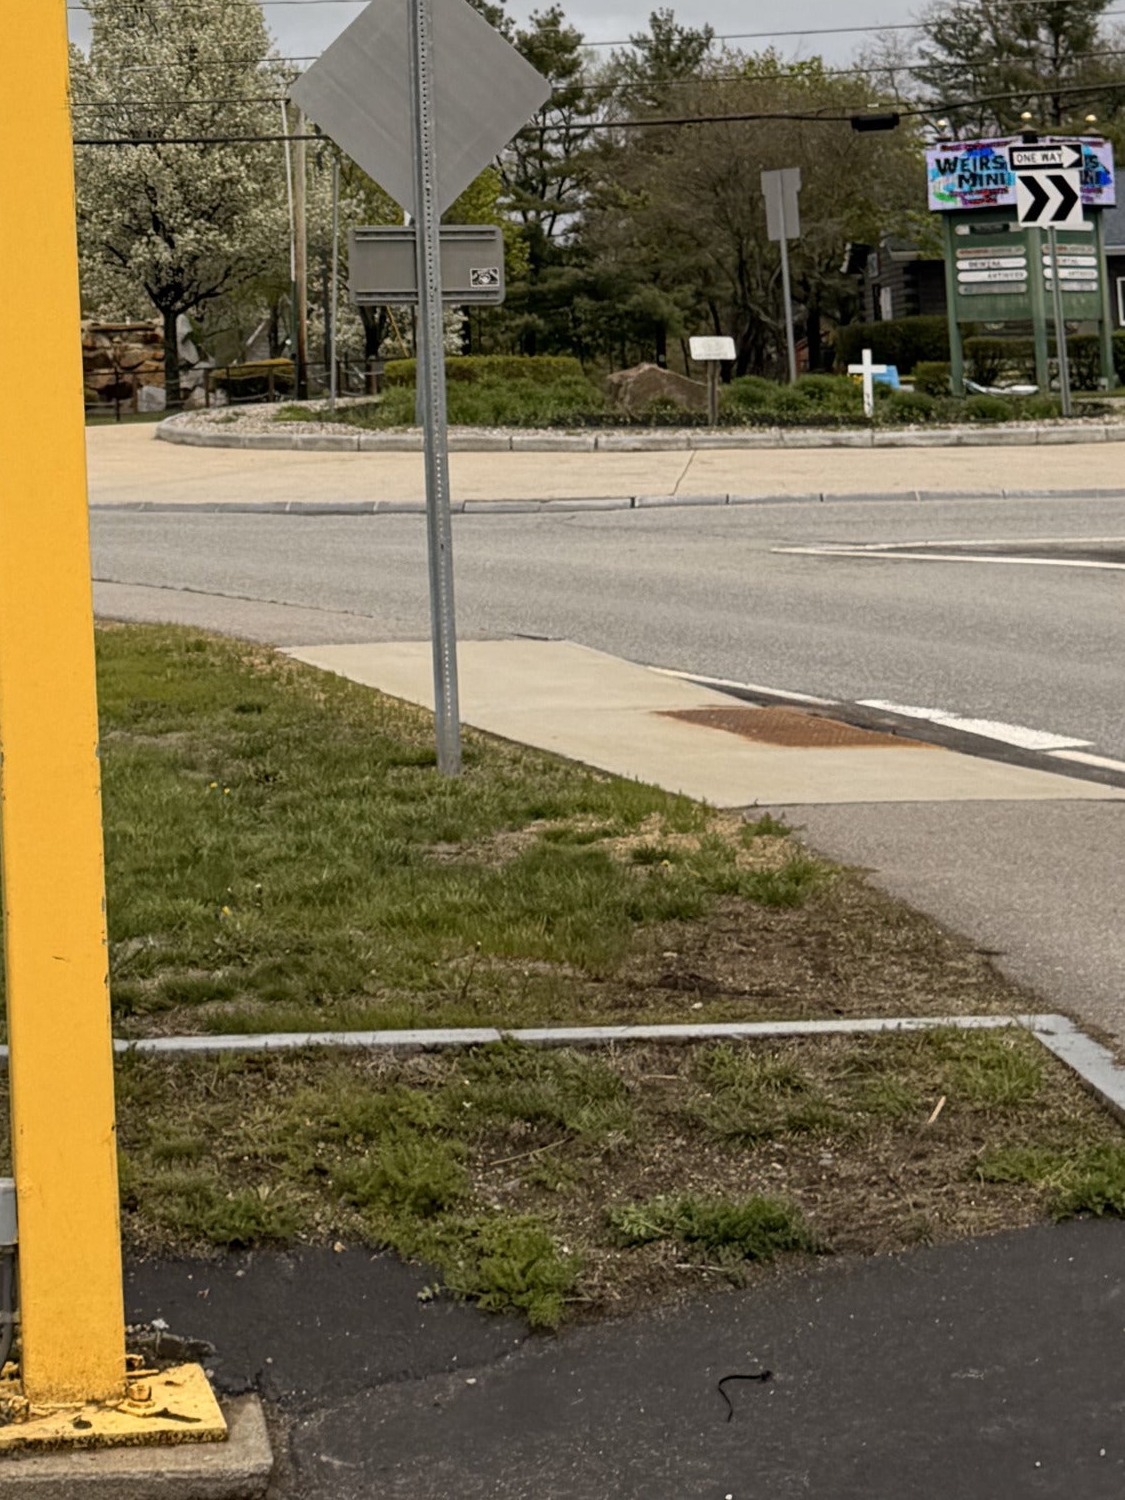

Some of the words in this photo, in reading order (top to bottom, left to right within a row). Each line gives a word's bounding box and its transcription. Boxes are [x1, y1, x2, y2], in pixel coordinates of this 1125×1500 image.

[935, 154, 1007, 175] WEIRS
[1017, 153, 1036, 164] ONE
[1041, 151, 1063, 162] WAY
